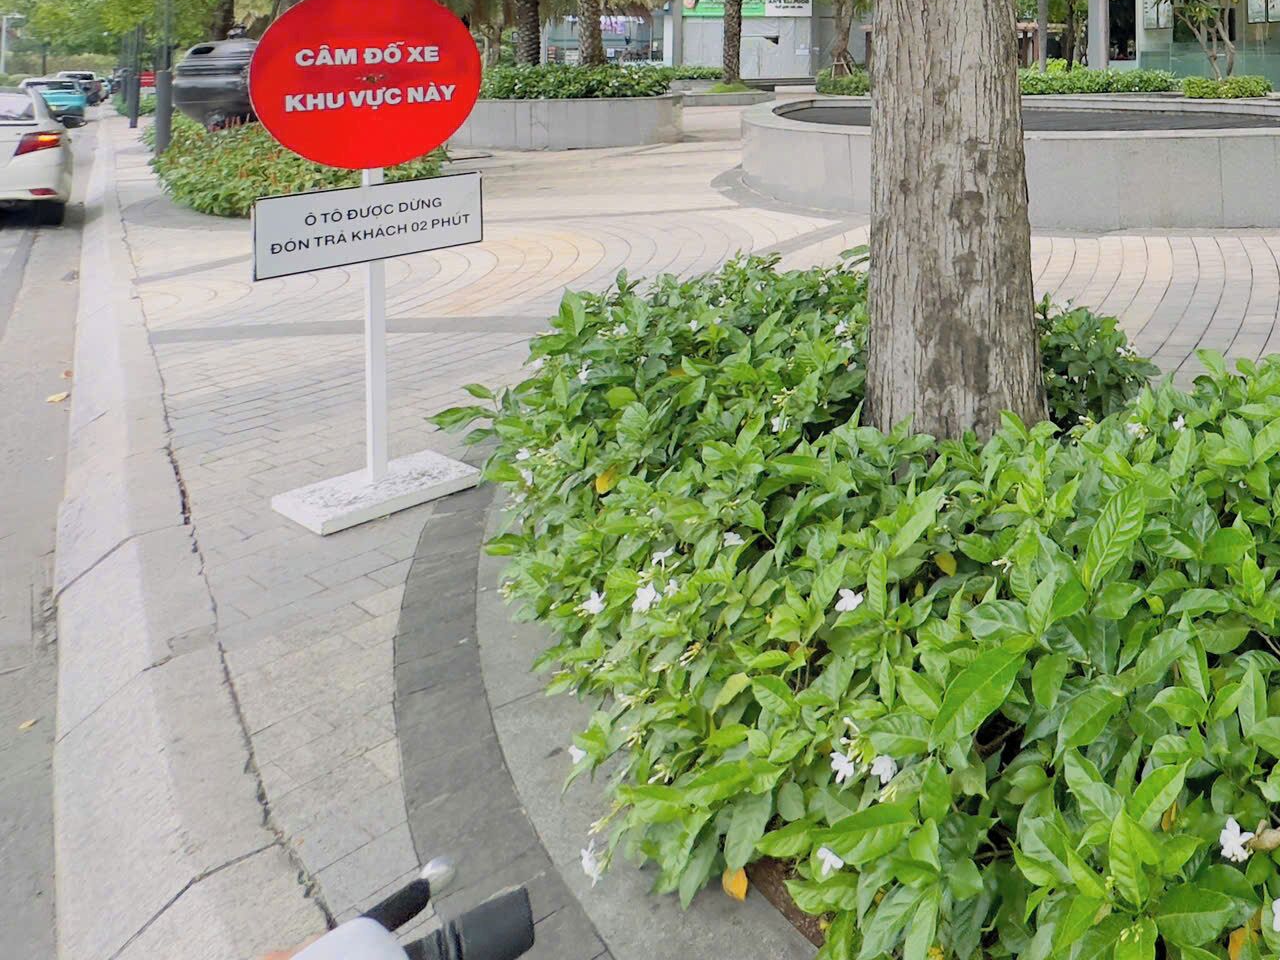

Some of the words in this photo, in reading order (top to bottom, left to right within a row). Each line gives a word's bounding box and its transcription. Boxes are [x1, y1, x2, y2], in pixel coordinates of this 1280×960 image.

[407, 46, 440, 63] XE
[285, 92, 345, 112] KHU
[349, 87, 402, 110] VỰC
[407, 82, 456, 103] NÀY
[304, 212, 317, 226] Ô
[321, 208, 343, 223] TÔ
[347, 203, 394, 221] ĐƯỢC
[399, 197, 442, 213] DỪNG
[271, 237, 310, 255] ĐÓN
[314, 229, 347, 248] TRẢ
[352, 223, 408, 242] KHÁCH
[411, 220, 428, 233] 02
[432, 210, 471, 229] PHÚT
